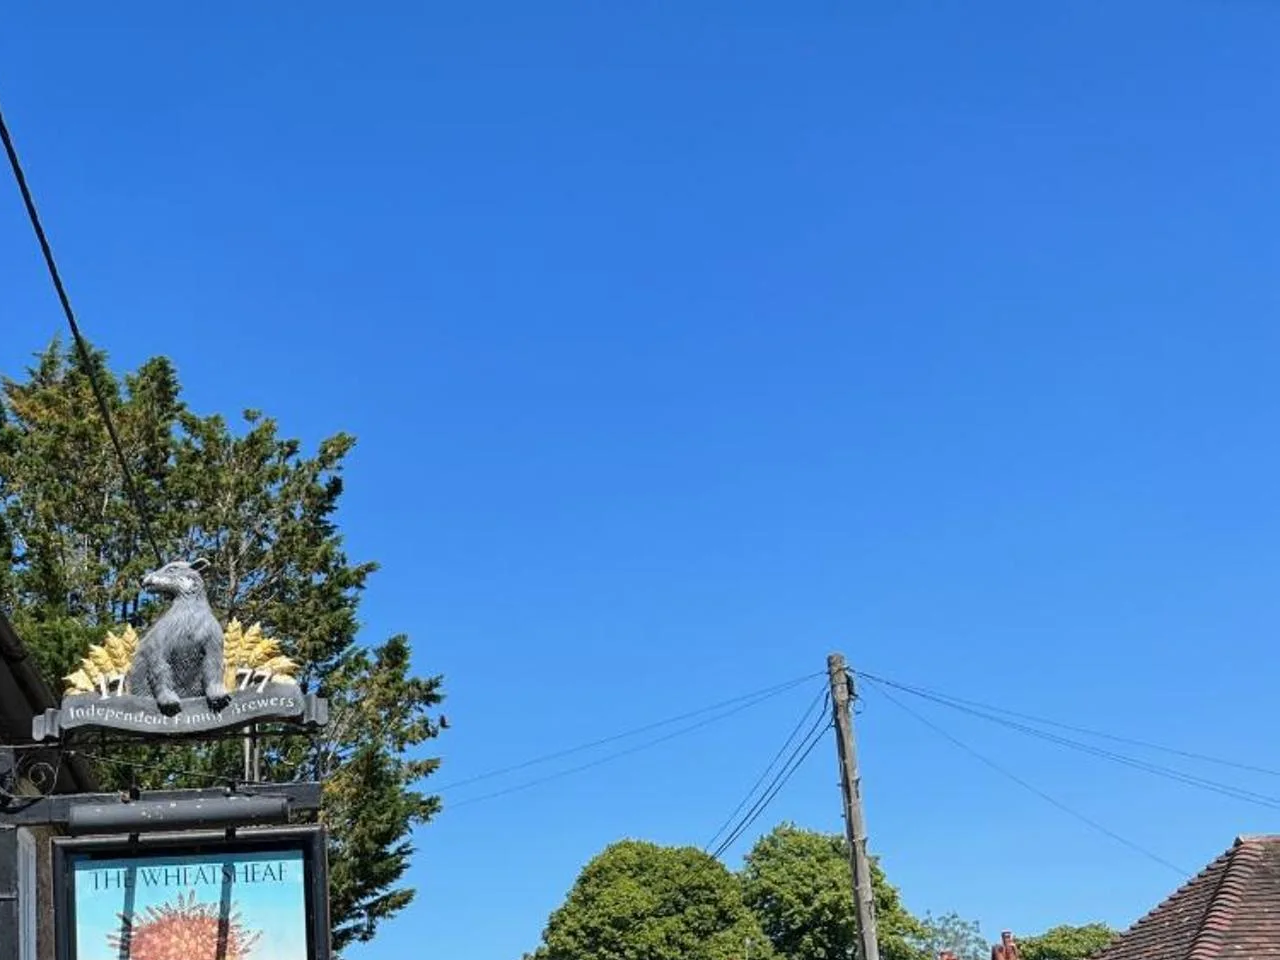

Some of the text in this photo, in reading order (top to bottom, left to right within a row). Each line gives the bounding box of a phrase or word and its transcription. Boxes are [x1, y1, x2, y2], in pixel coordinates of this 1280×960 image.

[69, 703, 170, 726] Independent
[232, 696, 295, 717] Brewers
[90, 861, 289, 891] THE WHEATSHEAF
